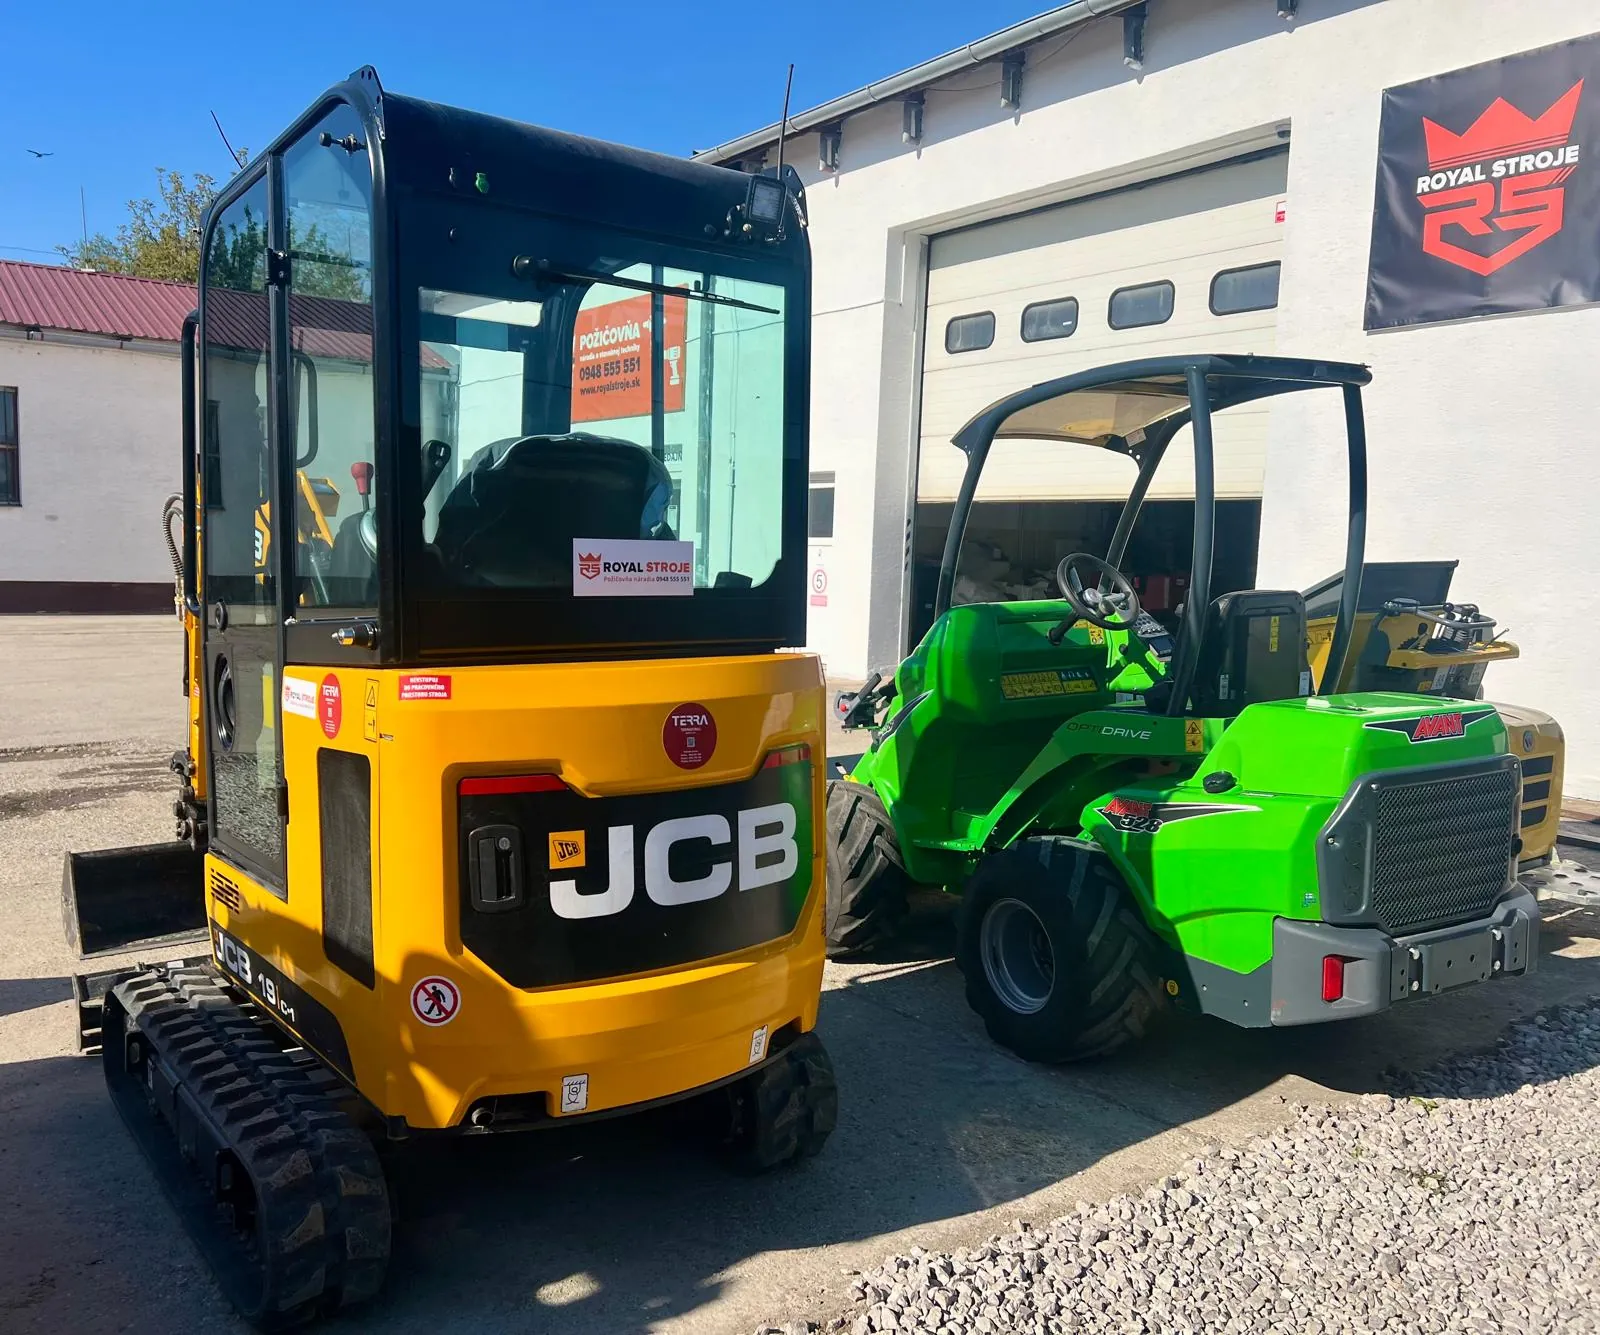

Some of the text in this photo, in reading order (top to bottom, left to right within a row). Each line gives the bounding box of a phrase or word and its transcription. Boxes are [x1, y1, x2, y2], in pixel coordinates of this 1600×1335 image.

[1416, 144, 1580, 194] ROYAL STROJE
[580, 320, 640, 350] POŽIČOVŇA
[580, 357, 640, 381] 0948 555 551
[580, 377, 640, 396] www.royalstroje.sk
[603, 562, 690, 573] ROYAL STROJE
[816, 574, 823, 589] 5
[671, 714, 709, 727] TERRA
[1412, 712, 1464, 740] AVANT
[1102, 796, 1153, 818] AVANT
[1120, 814, 1163, 834] 528
[549, 802, 798, 920] JCB
[558, 841, 579, 859] JCB
[213, 930, 252, 985] JCB
[258, 972, 276, 1006] 19
